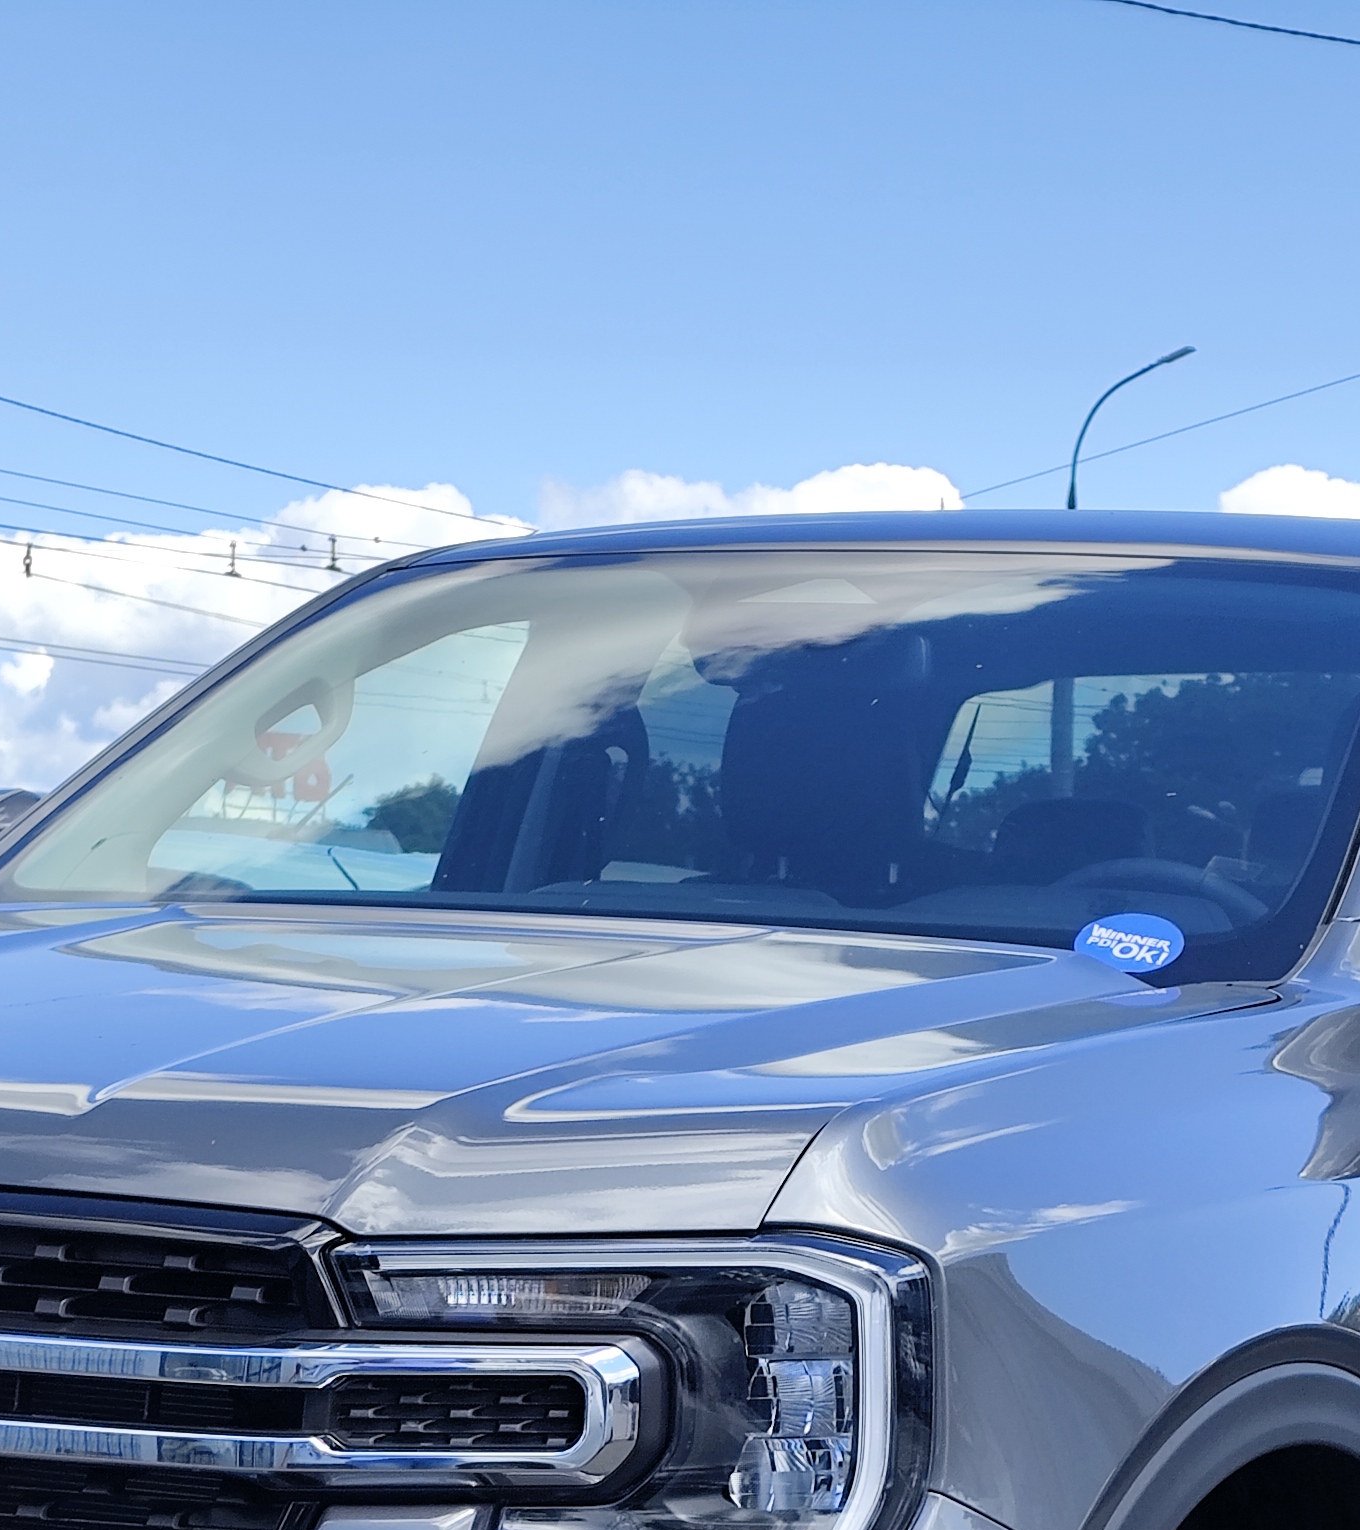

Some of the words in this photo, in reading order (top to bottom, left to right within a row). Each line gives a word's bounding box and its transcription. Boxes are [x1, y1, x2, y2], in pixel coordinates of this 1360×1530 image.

[1086, 936, 1118, 949] PDI
[1112, 942, 1170, 966] OK!
[1091, 923, 1171, 953] WINNER
